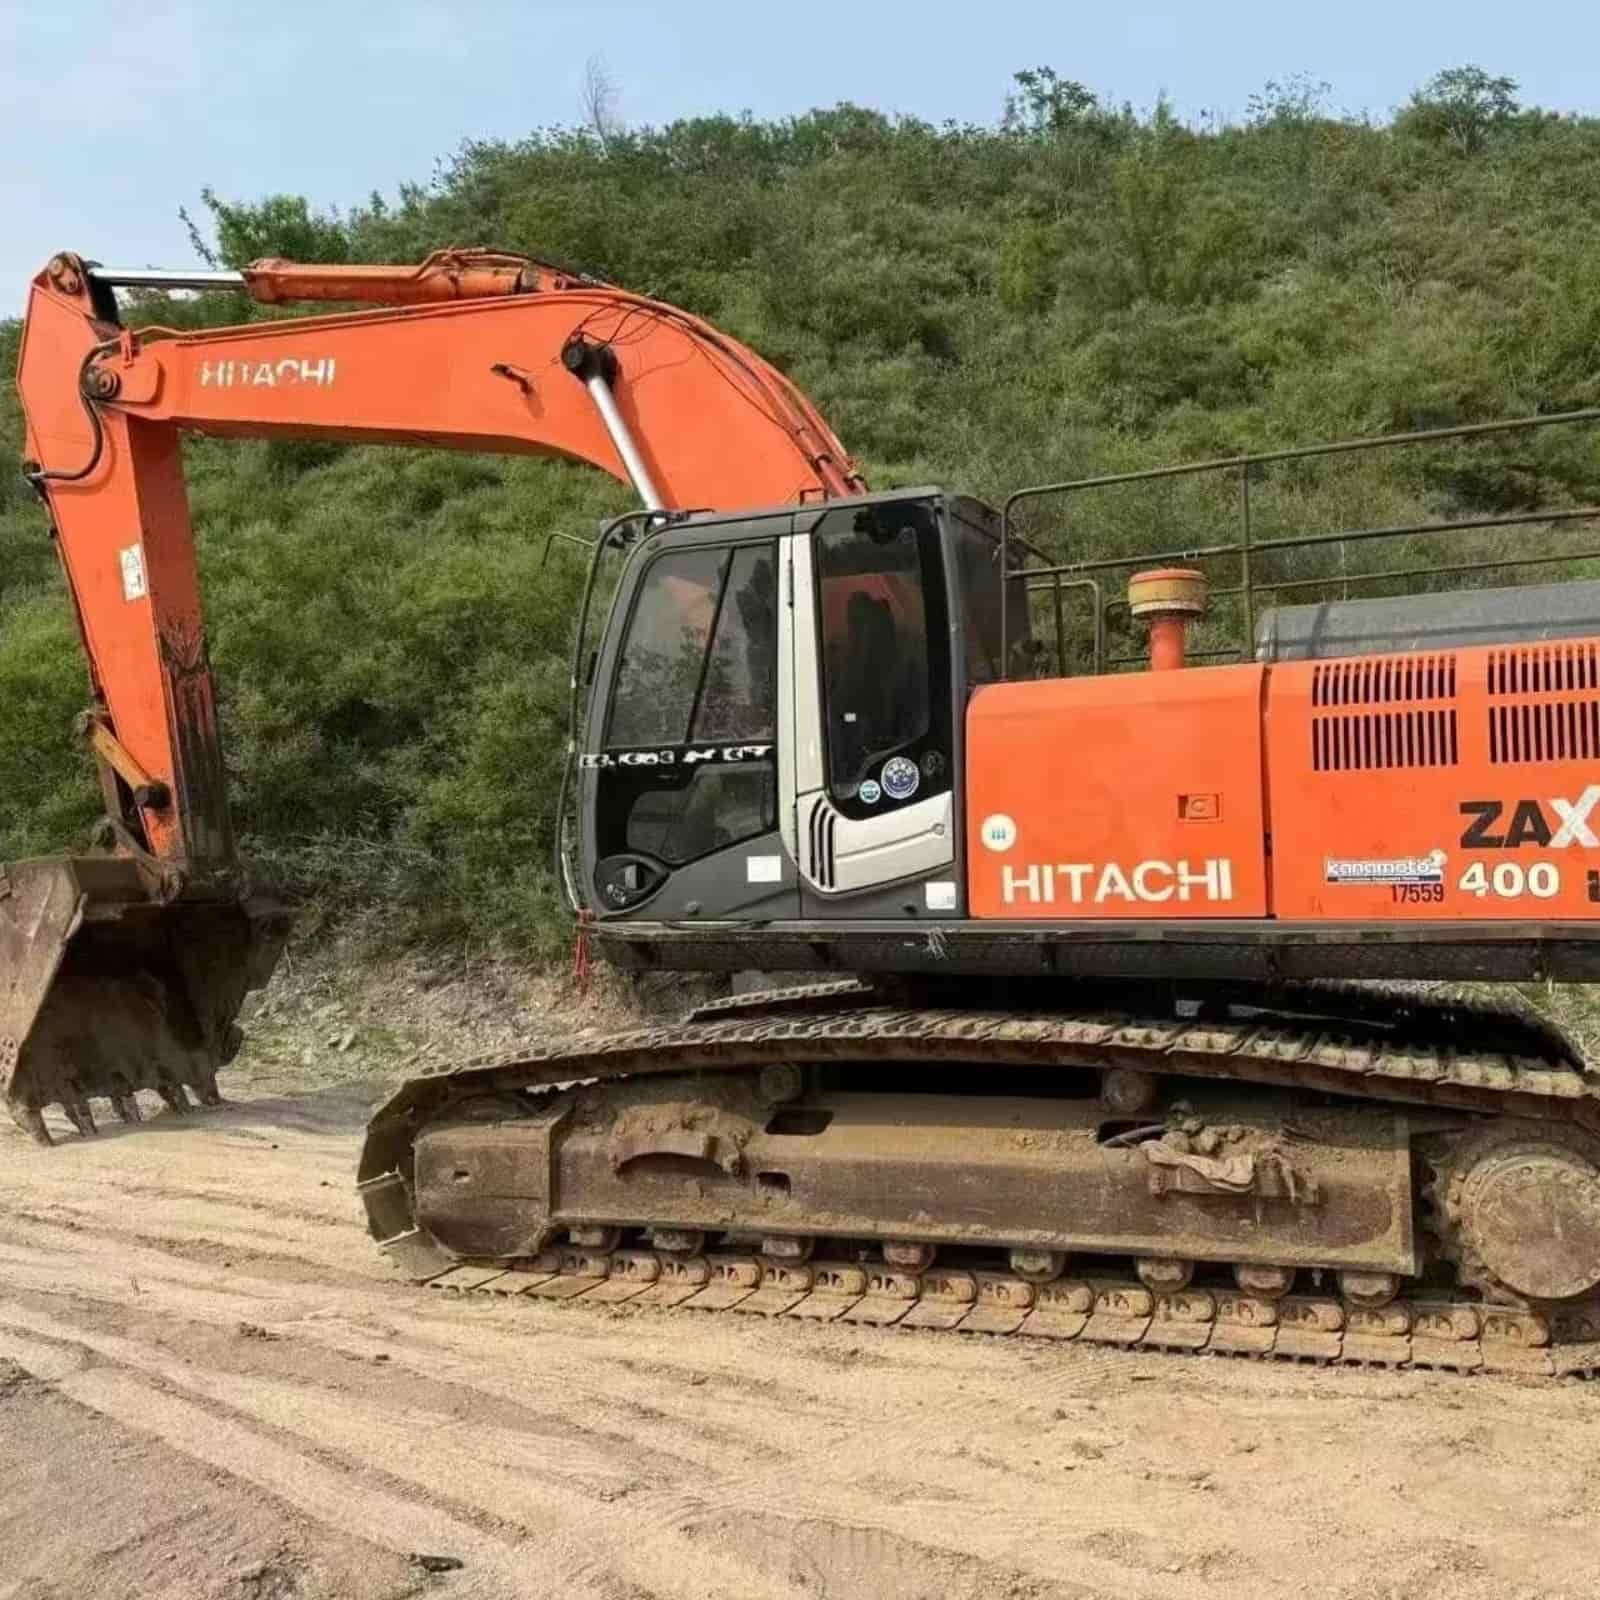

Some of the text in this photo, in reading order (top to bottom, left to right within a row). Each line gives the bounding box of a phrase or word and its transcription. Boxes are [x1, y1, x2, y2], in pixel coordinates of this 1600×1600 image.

[1459, 784, 1600, 849] ZAX
[1002, 858, 1233, 903] HITACHI
[1391, 883, 1444, 903] 17559
[1459, 861, 1560, 898] 400
